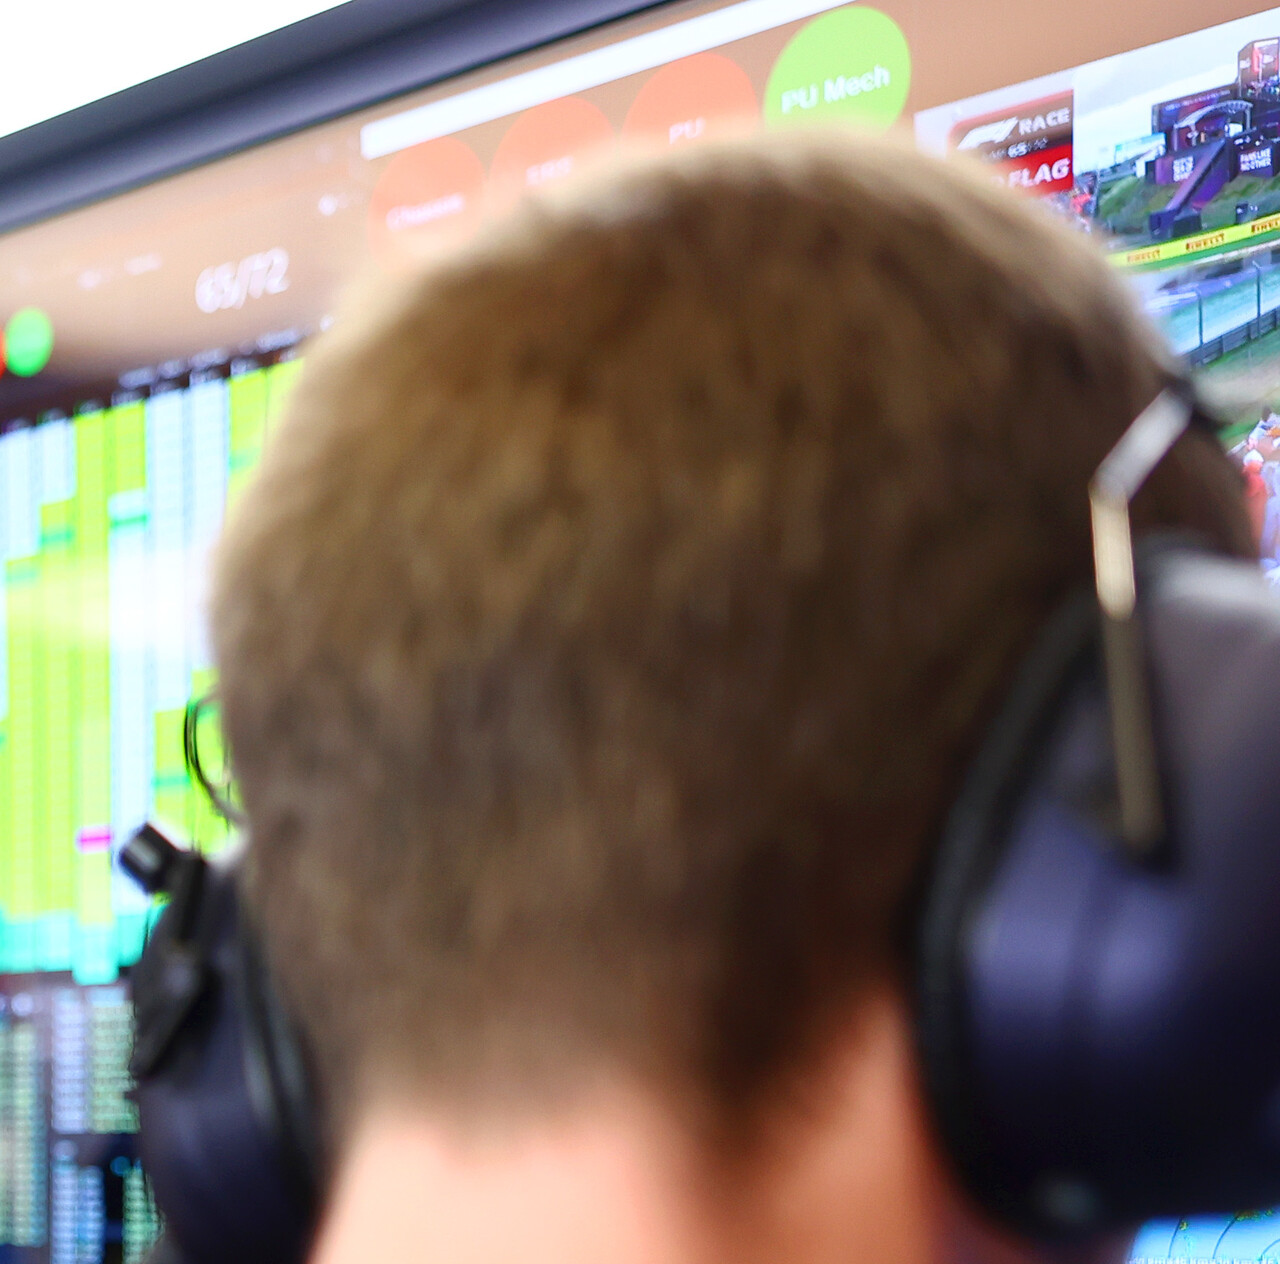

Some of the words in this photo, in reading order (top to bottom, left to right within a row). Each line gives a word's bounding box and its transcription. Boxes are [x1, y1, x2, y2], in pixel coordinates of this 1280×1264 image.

[781, 84, 818, 113] PU
[823, 65, 890, 103] Mech
[1018, 107, 1070, 135] RACE
[1008, 157, 1070, 188] FLAG
